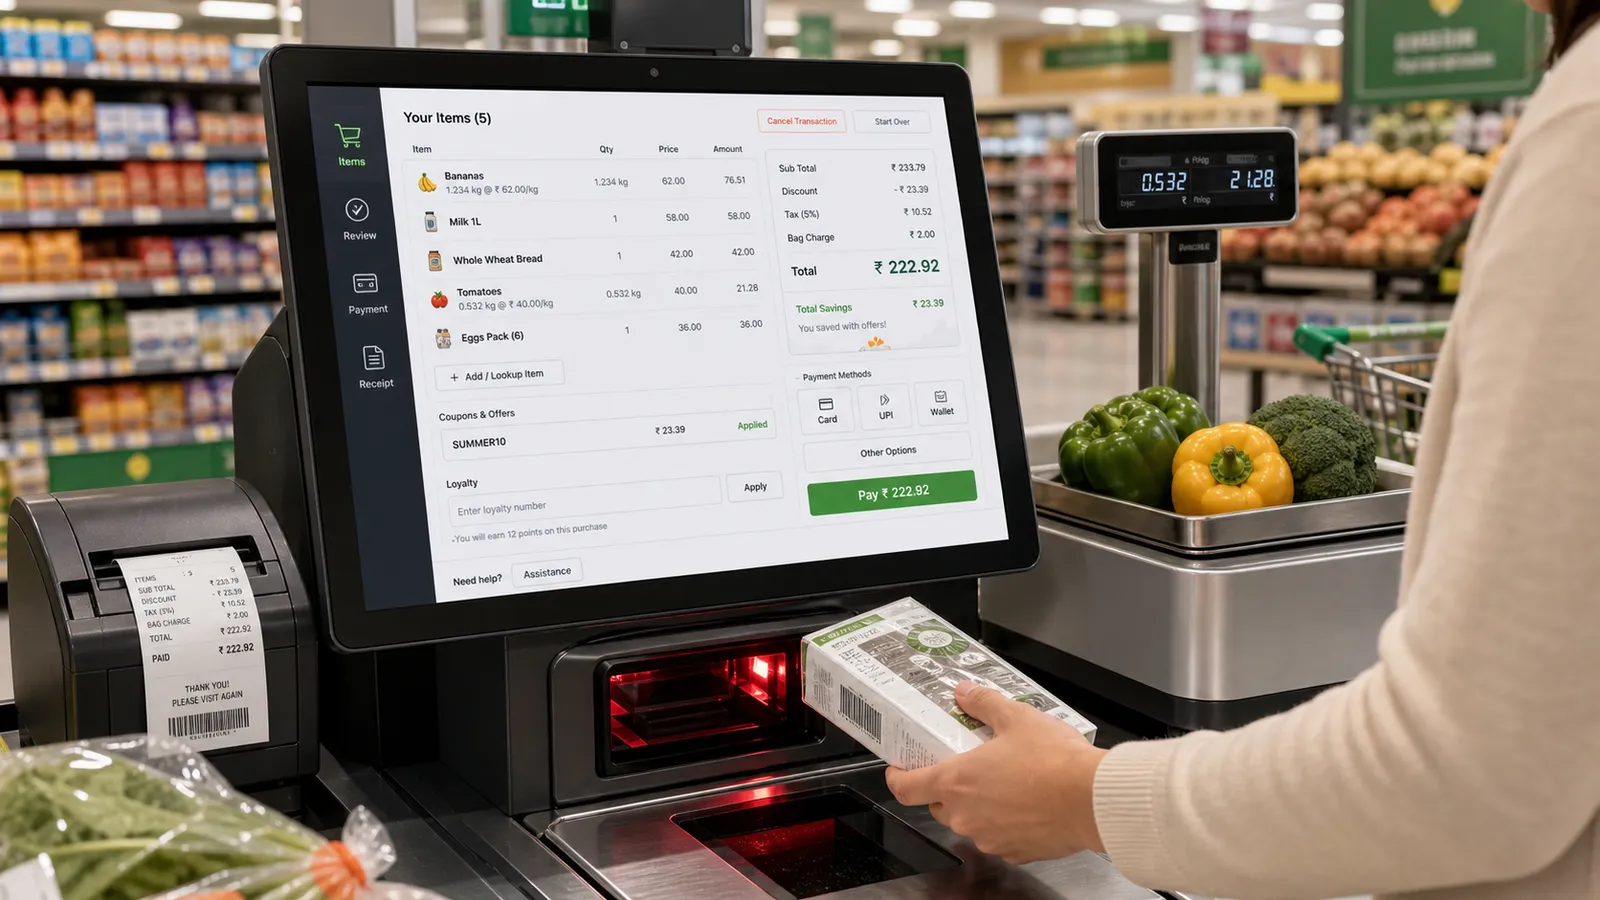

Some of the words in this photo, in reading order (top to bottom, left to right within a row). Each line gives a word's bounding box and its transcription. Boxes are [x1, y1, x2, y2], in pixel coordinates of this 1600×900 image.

[403, 112, 433, 123] Your
[436, 112, 471, 123] Items
[475, 112, 491, 126] (5)
[767, 117, 793, 125] Cancel
[794, 117, 837, 125] Transaction
[413, 145, 432, 153] Item
[600, 145, 613, 154] Qty
[659, 145, 678, 153] Price
[713, 145, 743, 153] Amount
[339, 157, 365, 166] Items
[779, 164, 795, 172] Sub
[796, 164, 816, 172] Total
[898, 163, 926, 171] 233.79
[445, 172, 484, 180] Bananas
[724, 176, 745, 184] 76.51
[594, 178, 616, 186] 1.234
[618, 178, 628, 188] kg
[662, 177, 685, 185] 62.00
[446, 186, 469, 194] 1.234
[471, 186, 482, 196] kg
[484, 185, 493, 195] @
[502, 185, 538, 195] 62.00/kg
[782, 187, 818, 195] Discount
[907, 185, 928, 193] 23.39
[728, 212, 750, 220] 58.00
[784, 210, 799, 218] Tax
[801, 210, 819, 219] (5%)
[904, 208, 908, 216] ₹
[450, 217, 469, 226] Milk
[471, 217, 481, 225] 1L
[666, 213, 689, 221] 58.00
[344, 231, 376, 240] Review
[788, 234, 804, 244] Bag
[806, 233, 834, 243] Charge
[917, 230, 935, 238] 2.00
[617, 252, 621, 260] 1
[670, 250, 693, 258] 42.00
[732, 248, 755, 256] 42.00
[453, 256, 482, 264] Whole
[484, 256, 514, 264] Wheat
[516, 254, 543, 263] Bread
[791, 266, 817, 276] Total
[874, 261, 882, 274] ₹
[889, 259, 940, 274] 222.92
[457, 288, 502, 296] Tomatoes
[674, 286, 698, 295] 40.00
[737, 284, 758, 292] 21.28
[606, 289, 629, 298] 0.532
[631, 289, 641, 299] kg
[459, 302, 483, 310] 0.532
[485, 301, 496, 311] kg
[497, 301, 506, 310] @
[509, 300, 513, 308] ₹
[516, 299, 553, 309] 40.00/kg
[913, 300, 917, 308] ₹
[920, 299, 944, 308] 23.39
[349, 305, 388, 316] Payment
[796, 305, 817, 313] Total
[819, 304, 852, 313] Savings
[678, 323, 702, 331] 36.00
[740, 320, 763, 328] 36.00
[816, 323, 840, 332] saved
[842, 322, 859, 330] with
[861, 321, 886, 329] offers!
[462, 334, 484, 344] Eggs
[487, 332, 509, 341] Pack
[511, 331, 524, 341] (6)
[466, 372, 483, 381] Add
[485, 372, 489, 381] /
[491, 371, 523, 380] Lookup
[525, 370, 544, 378] Item
[803, 373, 837, 382] Payment
[838, 370, 872, 379] Methods
[360, 379, 394, 389] Receipt
[439, 413, 478, 422] Coupons
[480, 411, 486, 419] &
[488, 409, 515, 418] Offers
[879, 411, 893, 419] UPI
[930, 408, 954, 416] Wallet
[818, 415, 837, 424] Card
[655, 427, 660, 435] ₹
[662, 425, 685, 434] 23.39
[738, 420, 768, 431] Applied
[453, 437, 506, 449] SUMMER10
[860, 449, 884, 457] Other
[885, 447, 917, 457] Options
[446, 479, 478, 489] Loyalty
[744, 482, 767, 493] Apply
[858, 490, 878, 502] Pay
[882, 488, 888, 498] ₹
[892, 484, 929, 498] 222.92
[458, 508, 481, 516] Enter
[483, 505, 512, 515] loyalty
[514, 502, 546, 511] number
[472, 533, 485, 541] will
[507, 530, 517, 538] 12
[518, 529, 543, 539] points
[556, 526, 571, 534] this
[573, 524, 607, 533] purchase
[524, 568, 571, 579] Assistance
[453, 576, 476, 586] Need
[478, 574, 502, 584] help?
